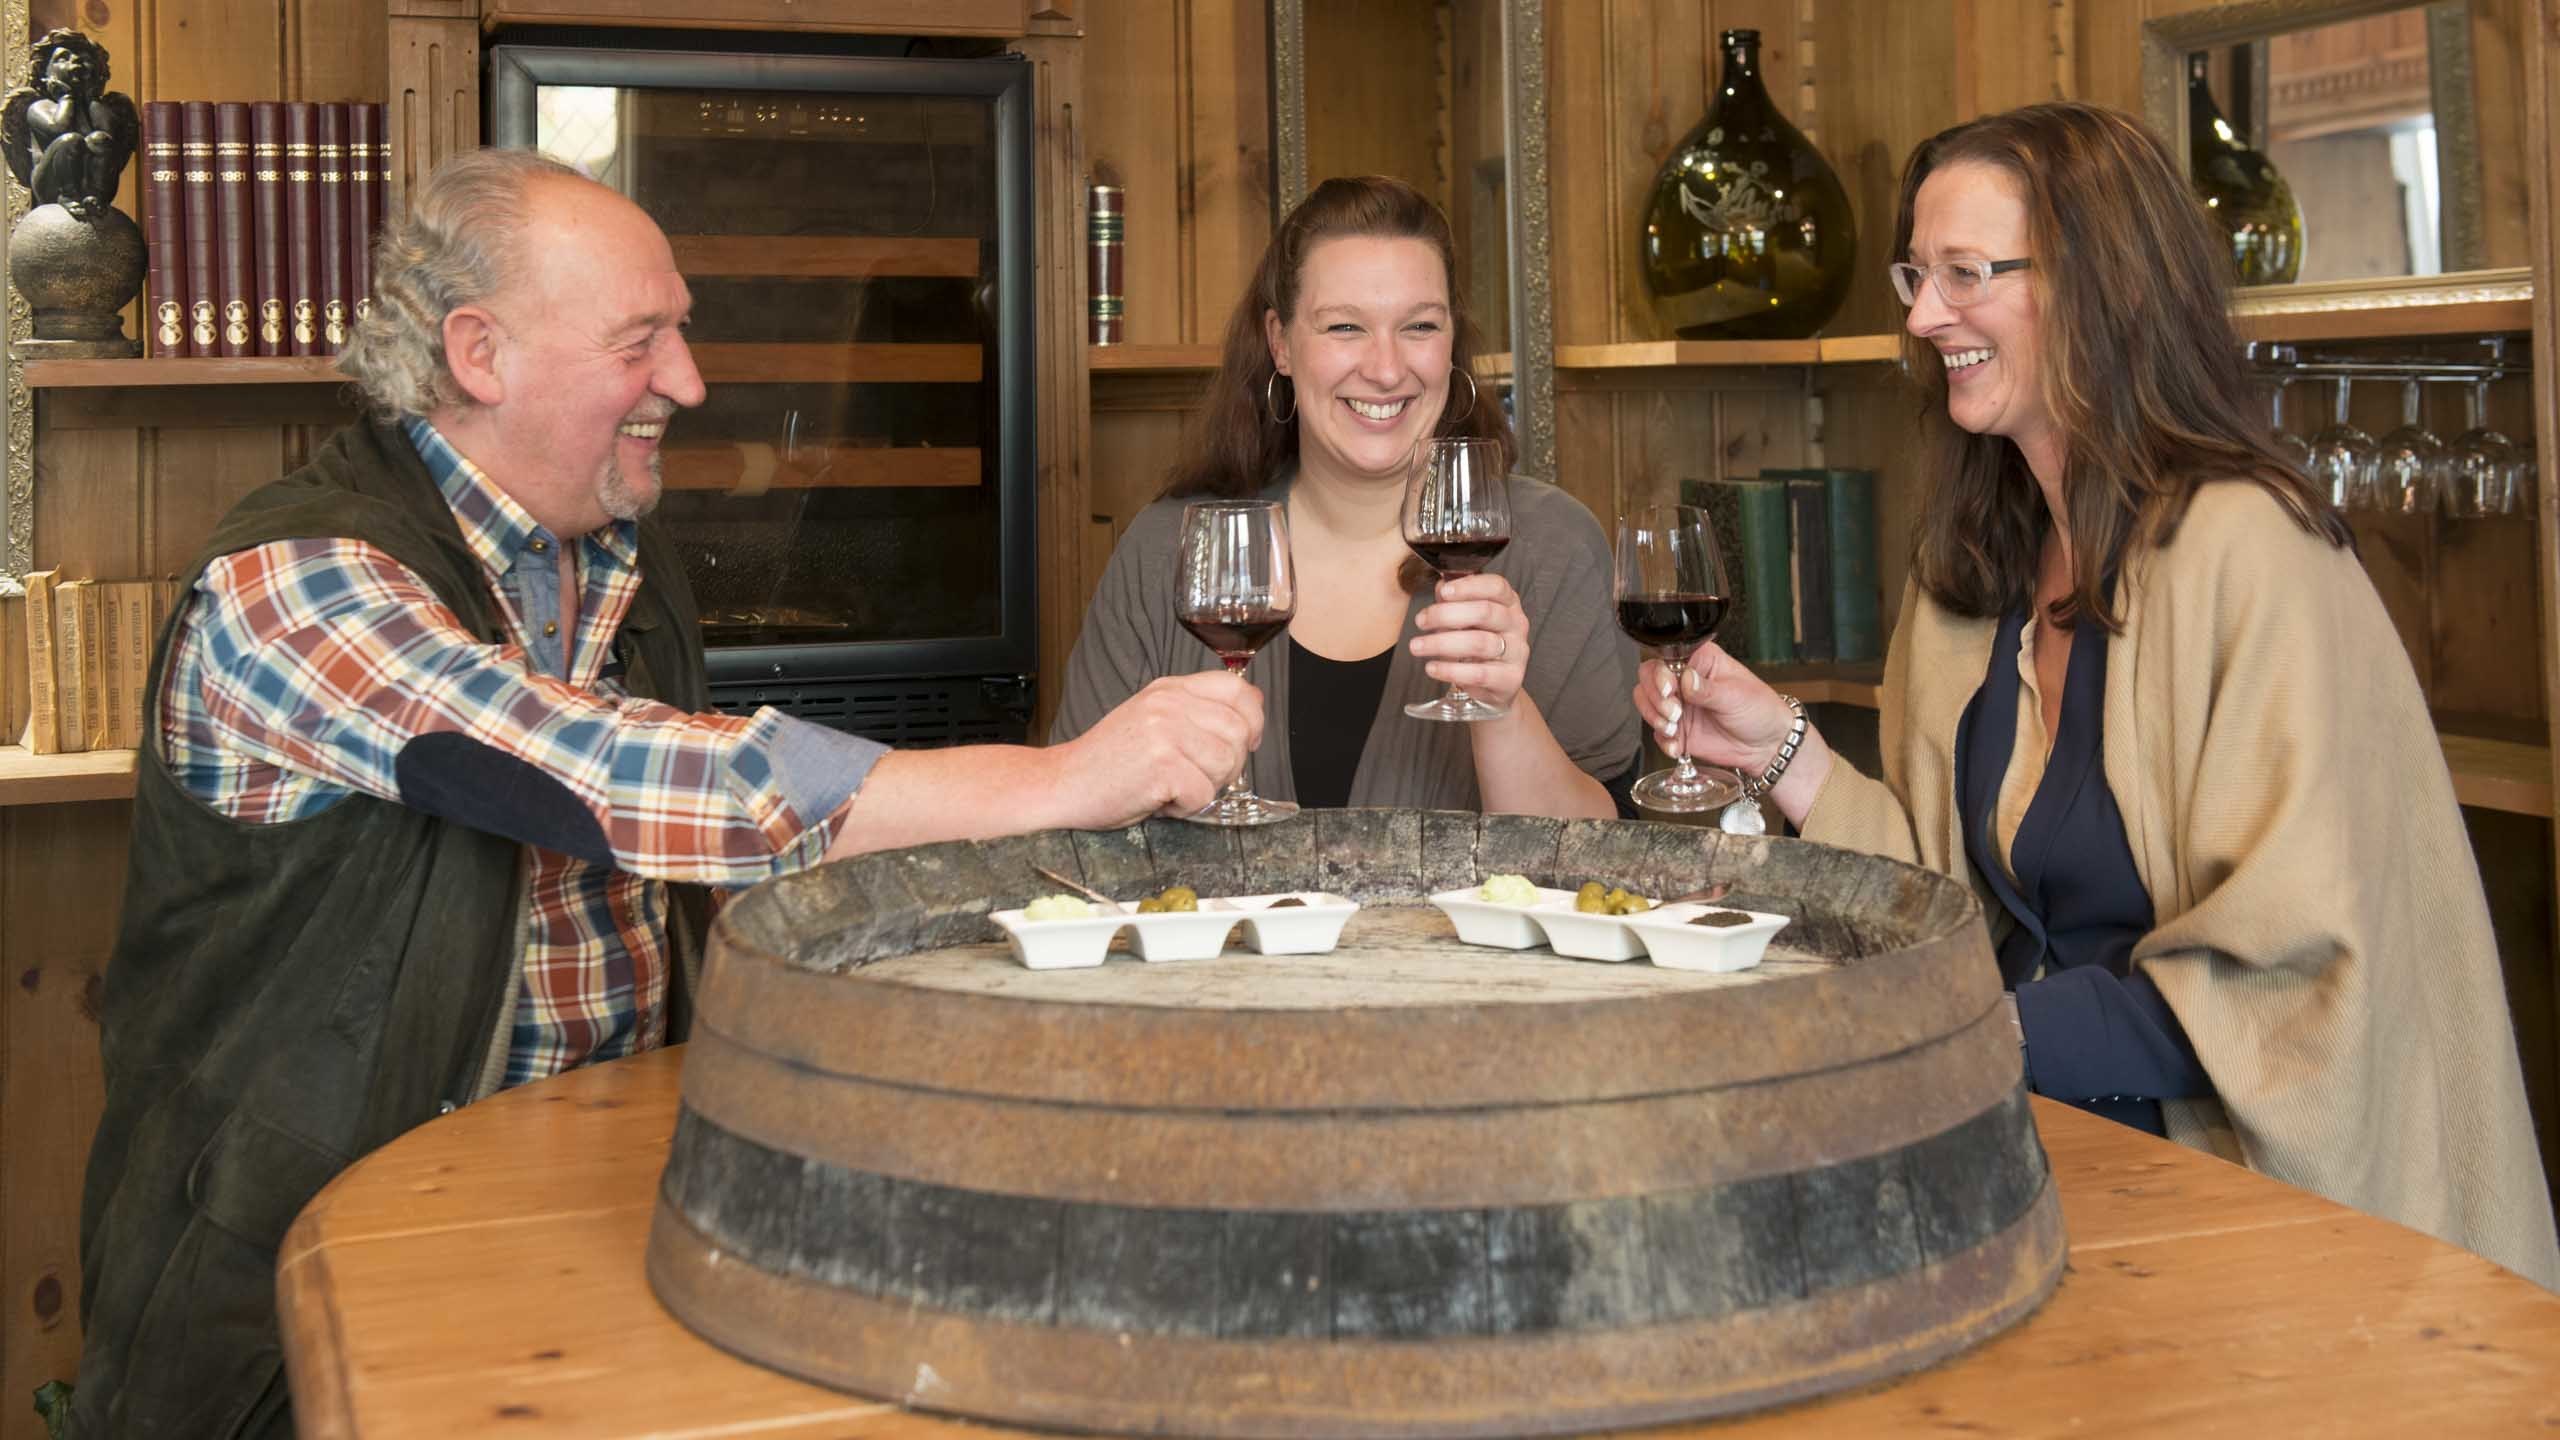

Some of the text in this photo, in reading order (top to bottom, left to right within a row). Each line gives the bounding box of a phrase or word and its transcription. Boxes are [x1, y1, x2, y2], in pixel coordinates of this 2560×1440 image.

[151, 171, 179, 182] 1979
[184, 171, 214, 182] 1980
[220, 171, 247, 182] 1981
